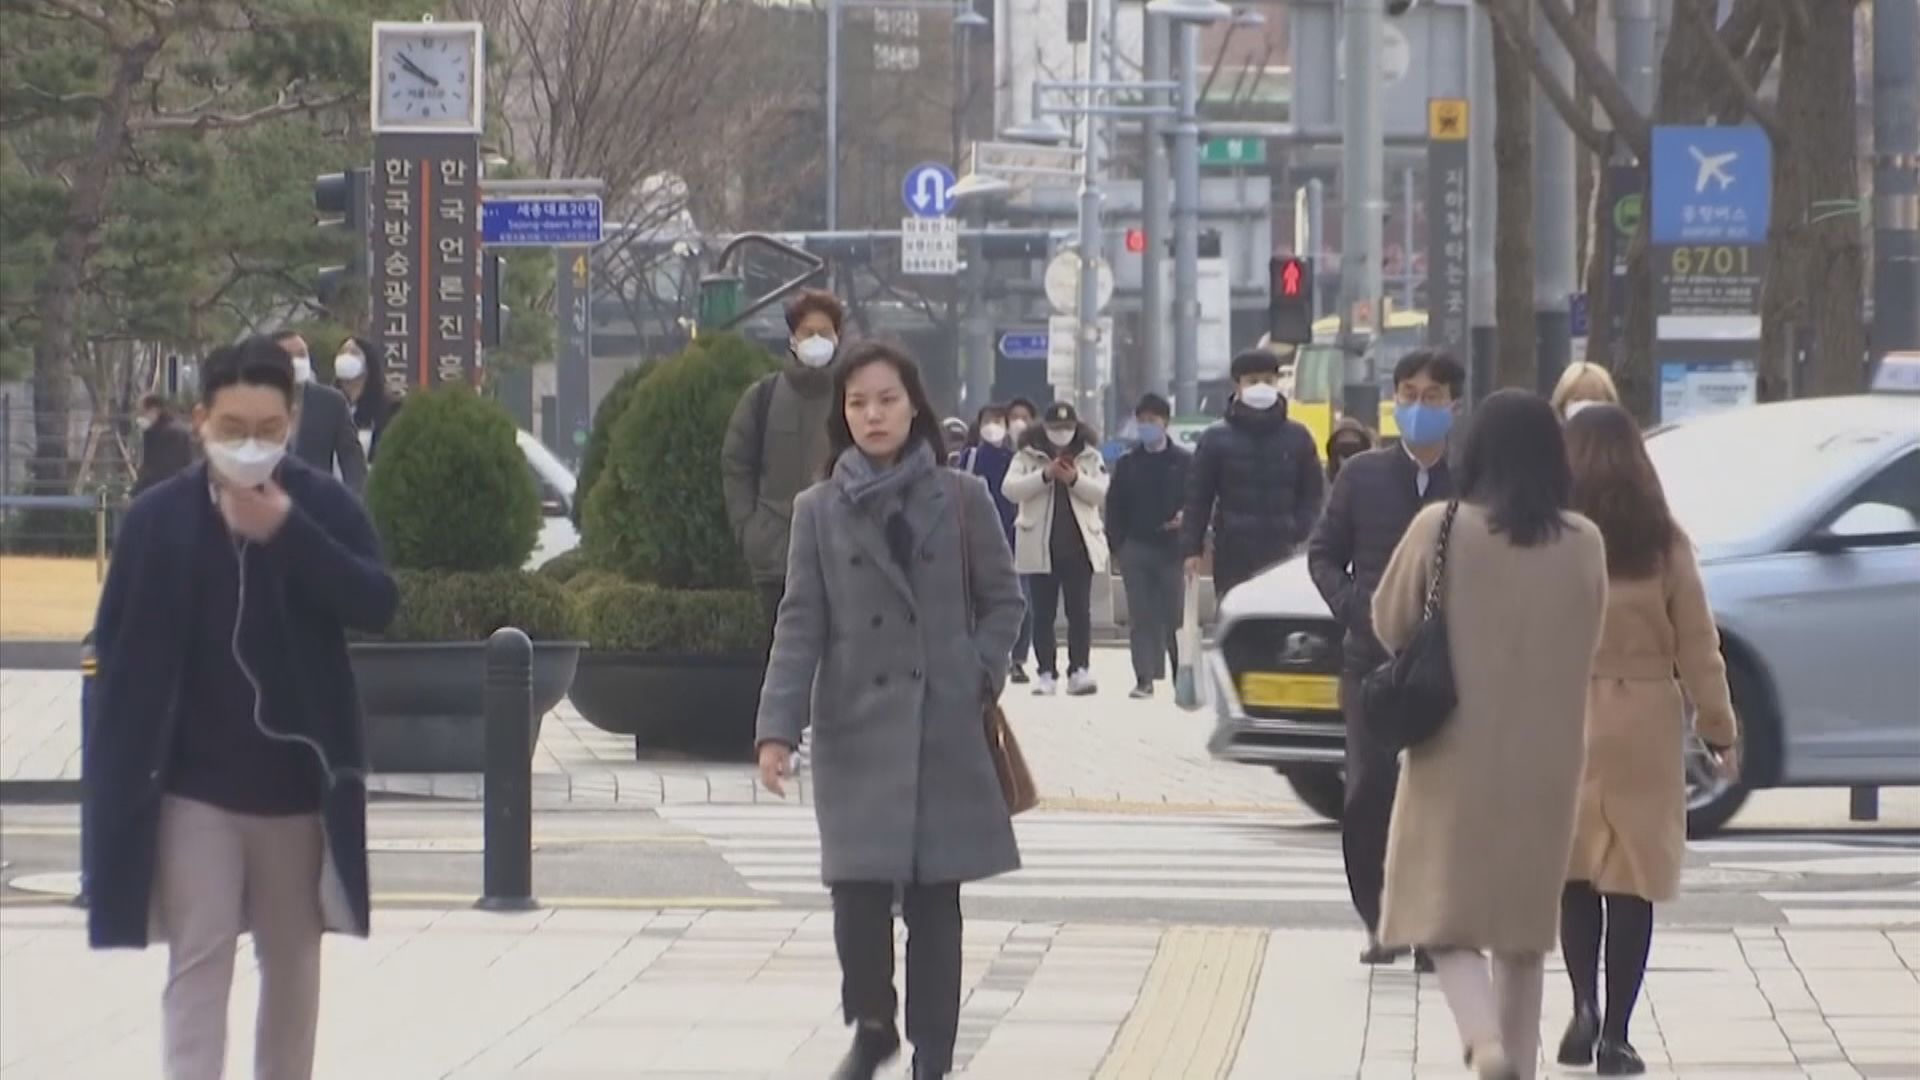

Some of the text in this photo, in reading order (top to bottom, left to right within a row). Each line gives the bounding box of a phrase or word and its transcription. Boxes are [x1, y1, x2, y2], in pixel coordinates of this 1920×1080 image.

[438, 159, 466, 382] 한국언론진흥
[572, 255, 586, 279] 4
[1671, 246, 1748, 274] 6701
